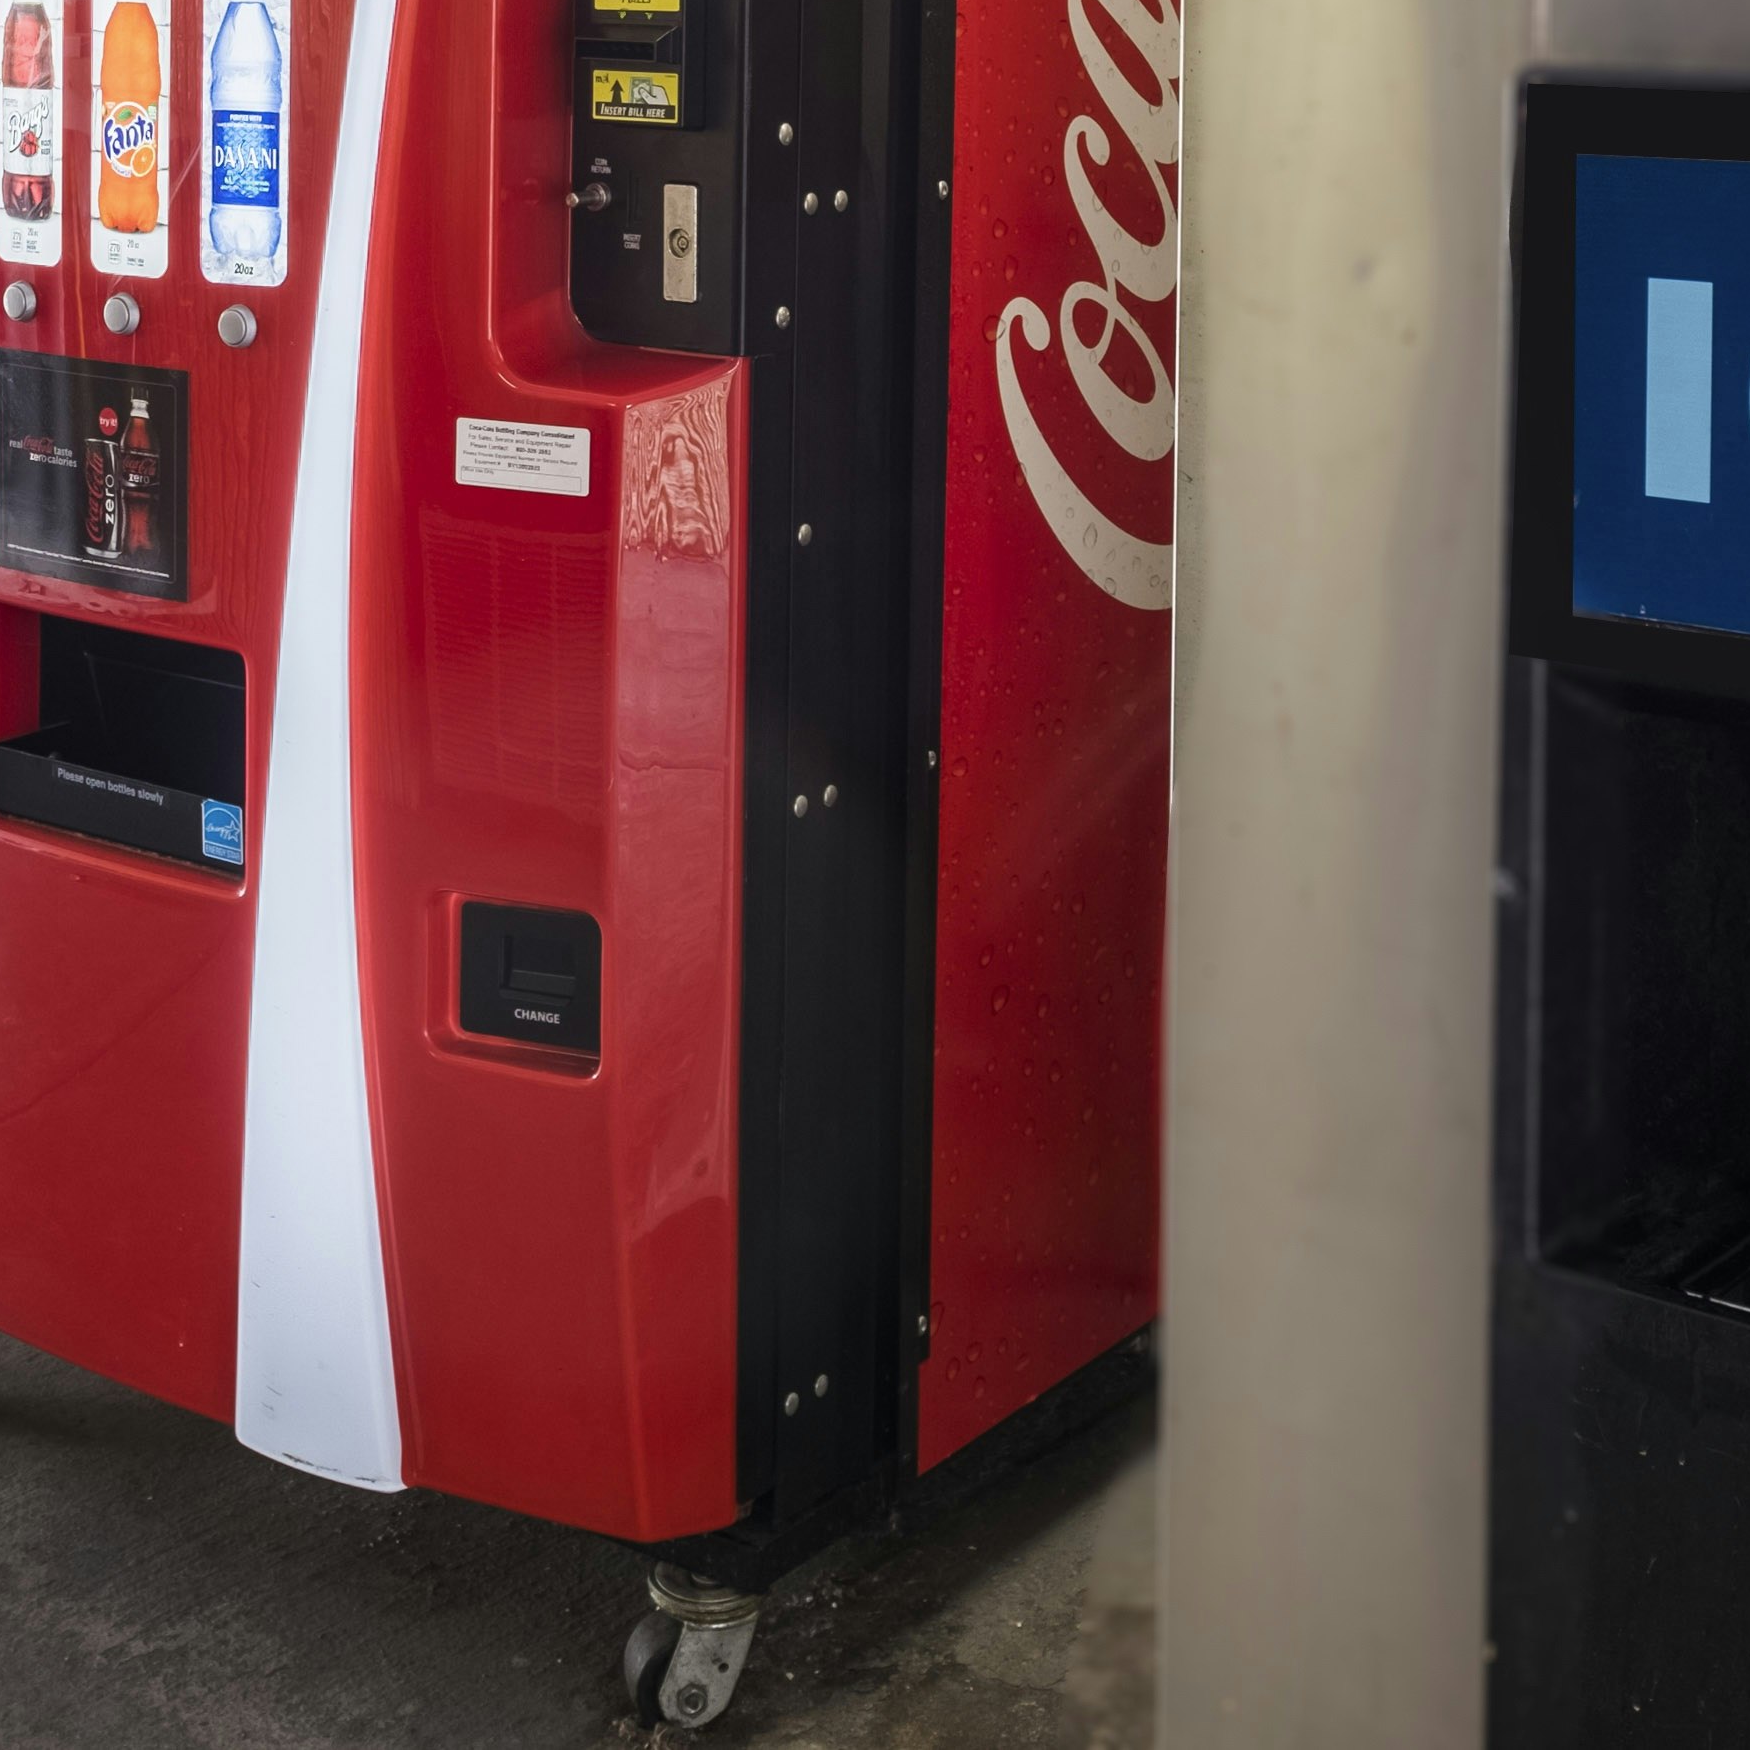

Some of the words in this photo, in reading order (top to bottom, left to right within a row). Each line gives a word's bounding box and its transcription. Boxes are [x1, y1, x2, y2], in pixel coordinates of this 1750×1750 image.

[600, 103, 627, 116] INSERT
[628, 106, 644, 117] BILL
[646, 108, 666, 118] HERE
[104, 115, 154, 160] Fanta
[214, 139, 278, 176] DASANI
[100, 417, 110, 427] try
[9, 439, 23, 449] real
[54, 446, 73, 458] taste
[30, 452, 47, 463] zero
[48, 455, 78, 468] calories
[128, 473, 151, 485] zero
[105, 474, 115, 525] zero
[58, 768, 84, 784] Please
[86, 776, 106, 790] open
[107, 780, 136, 798] bottles
[138, 788, 164, 806] slowly
[514, 1008, 561, 1026] CHANGE
